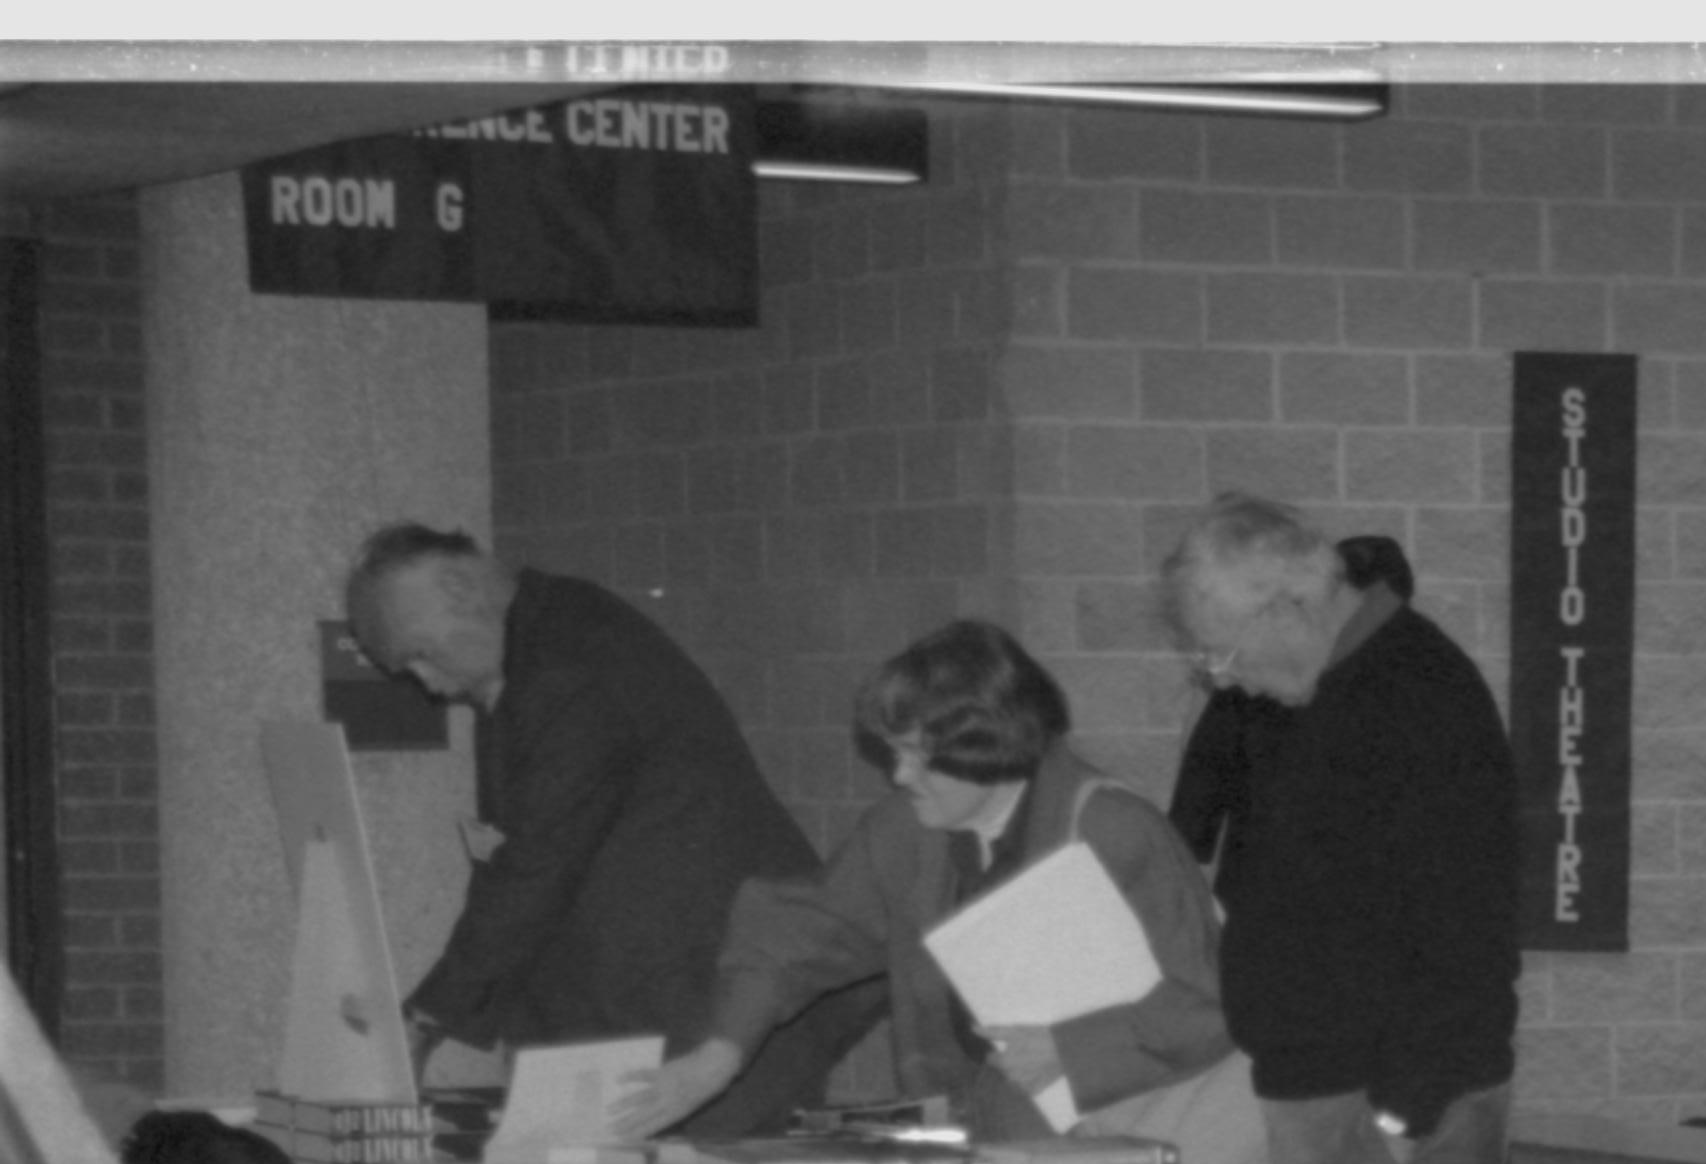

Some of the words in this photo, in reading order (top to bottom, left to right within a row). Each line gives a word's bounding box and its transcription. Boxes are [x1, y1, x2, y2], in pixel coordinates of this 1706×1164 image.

[566, 98, 730, 155] CENTER
[270, 175, 396, 230] ROOM
[435, 182, 464, 233] G
[1559, 387, 1587, 627] STUDIO
[1554, 646, 1585, 925] THEATRE
